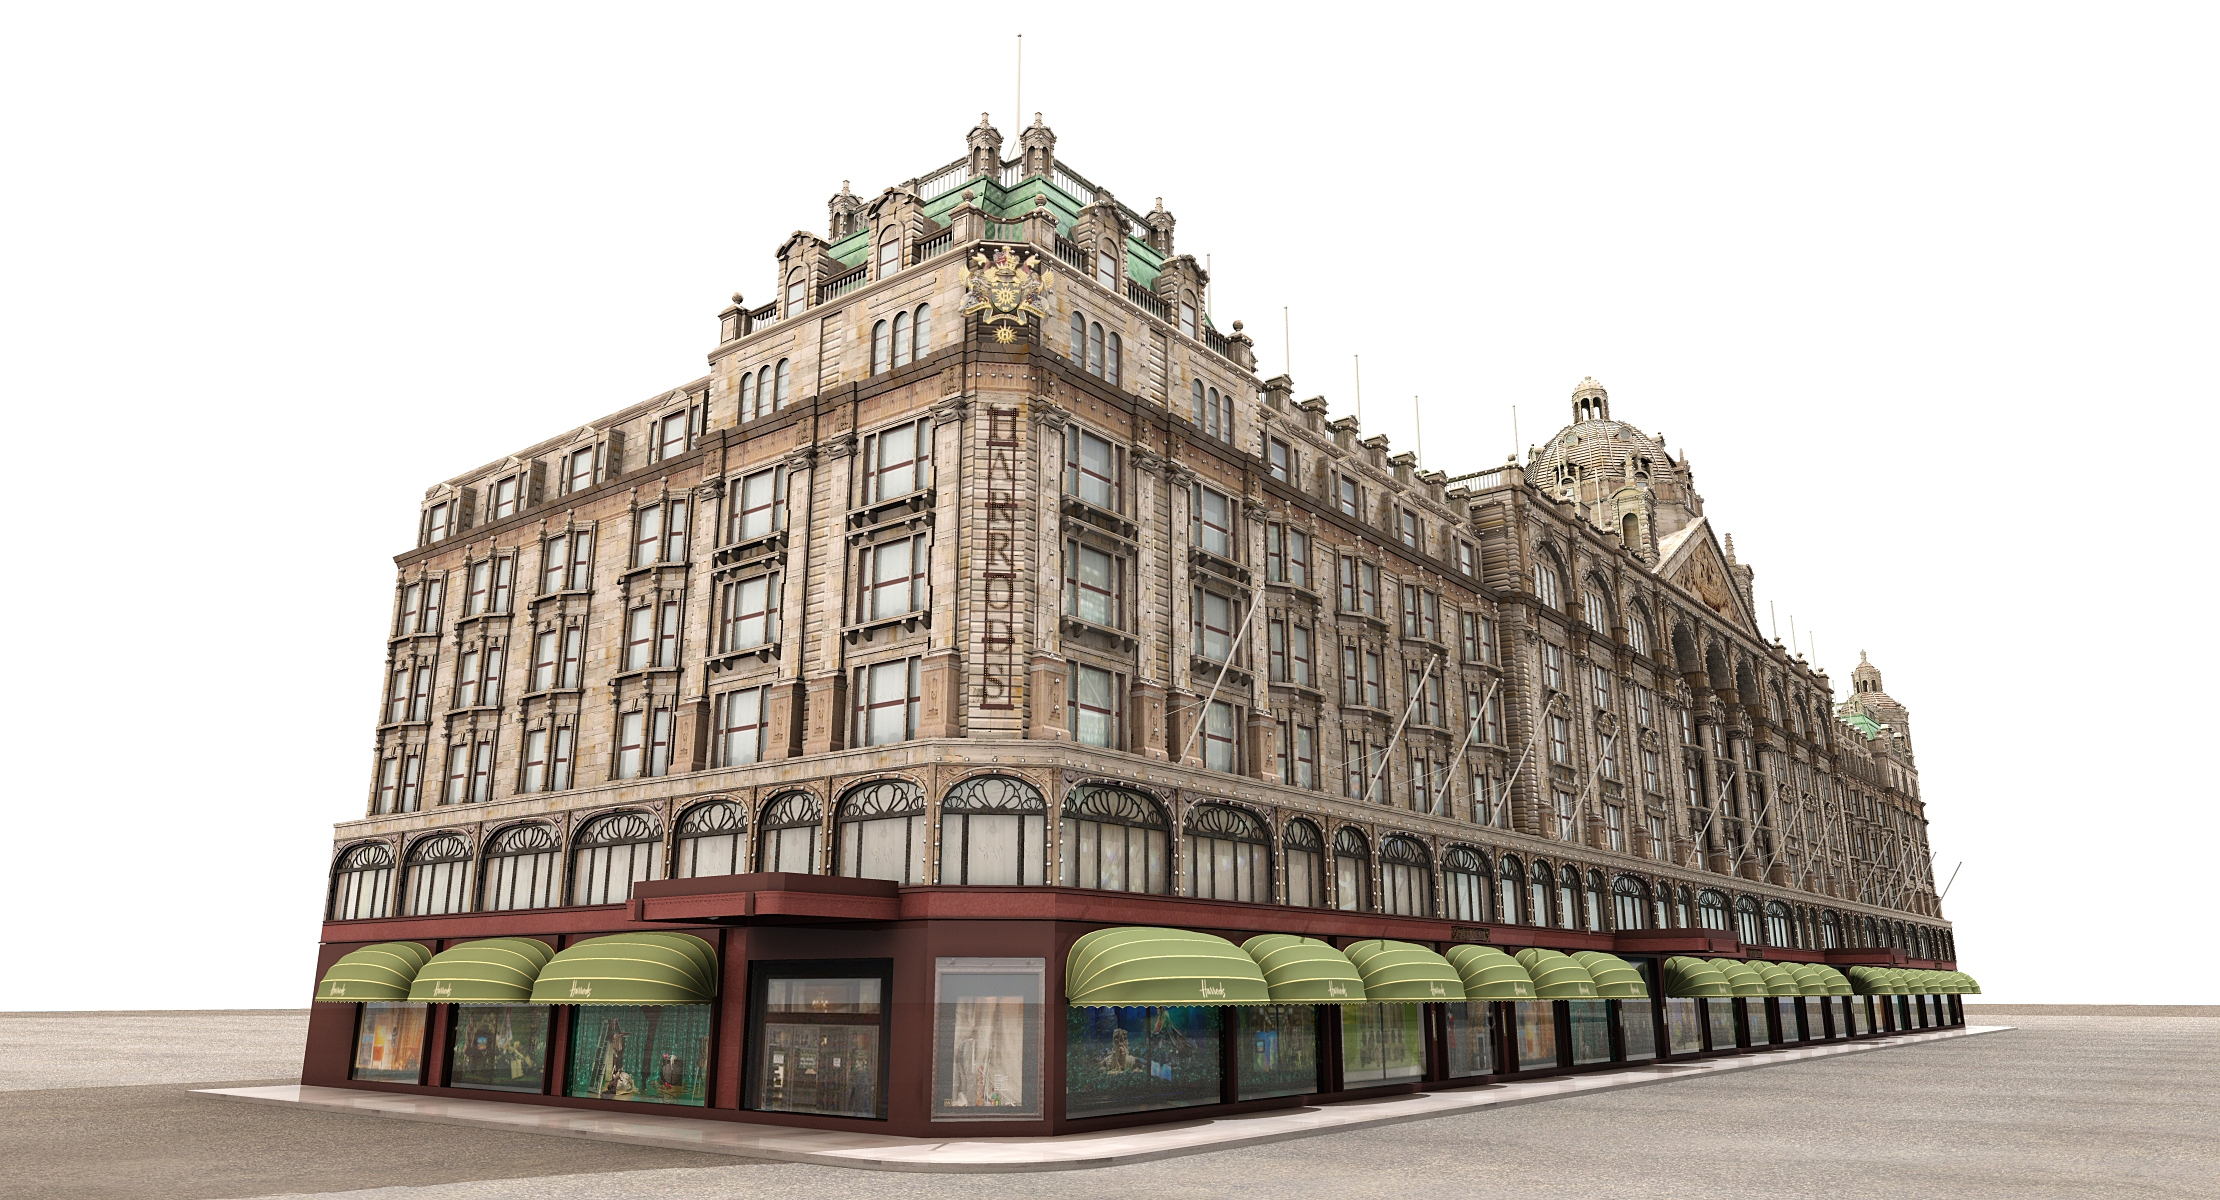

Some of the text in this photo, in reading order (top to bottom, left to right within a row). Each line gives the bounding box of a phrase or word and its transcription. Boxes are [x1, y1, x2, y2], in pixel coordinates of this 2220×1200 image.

[984, 406, 1018, 698] HARRODS
[569, 980, 592, 998] Harrods
[1199, 979, 1226, 999] Harrods
[1328, 980, 1348, 998] Harrods
